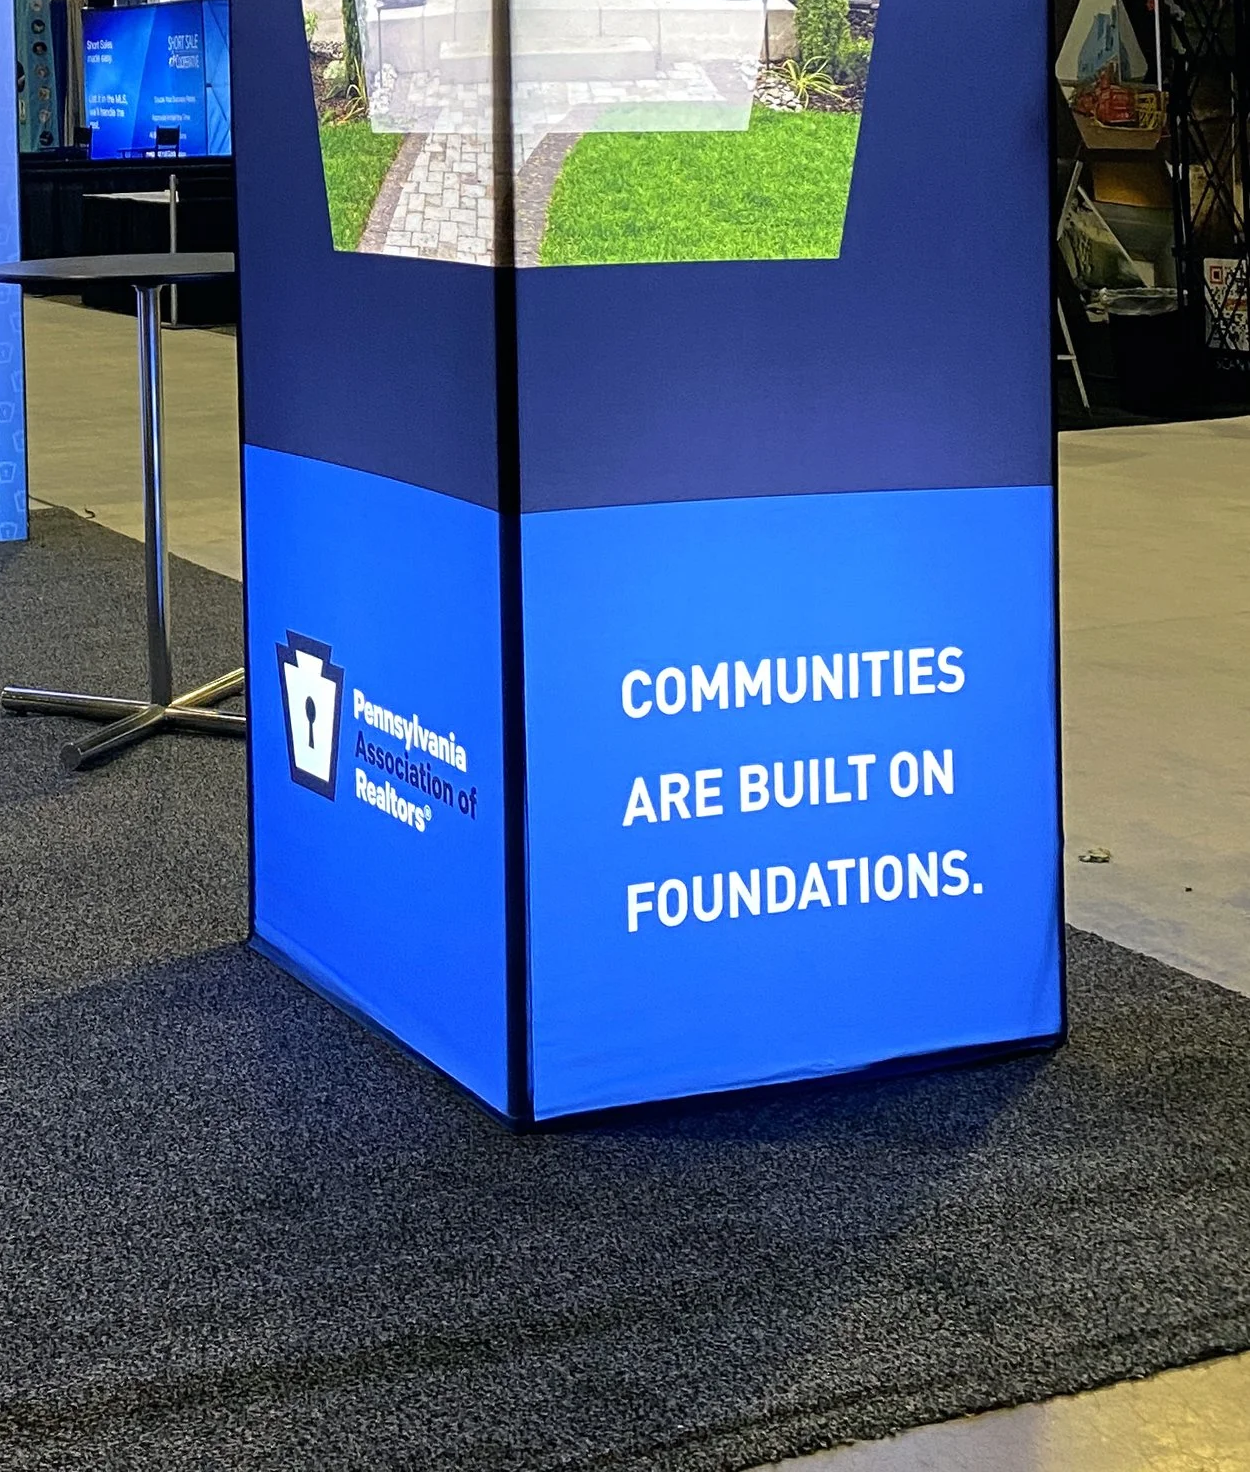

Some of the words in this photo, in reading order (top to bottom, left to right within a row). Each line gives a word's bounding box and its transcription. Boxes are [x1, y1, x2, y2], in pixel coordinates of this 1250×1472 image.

[621, 646, 965, 719] COMMUNITIES
[353, 688, 466, 773] Pennsylvania
[355, 730, 454, 808] Association
[458, 786, 477, 820] of
[622, 768, 724, 827] ARE
[739, 753, 876, 813] BUILT
[889, 748, 954, 798] ON
[627, 849, 983, 933] FOUNDATIONS.
